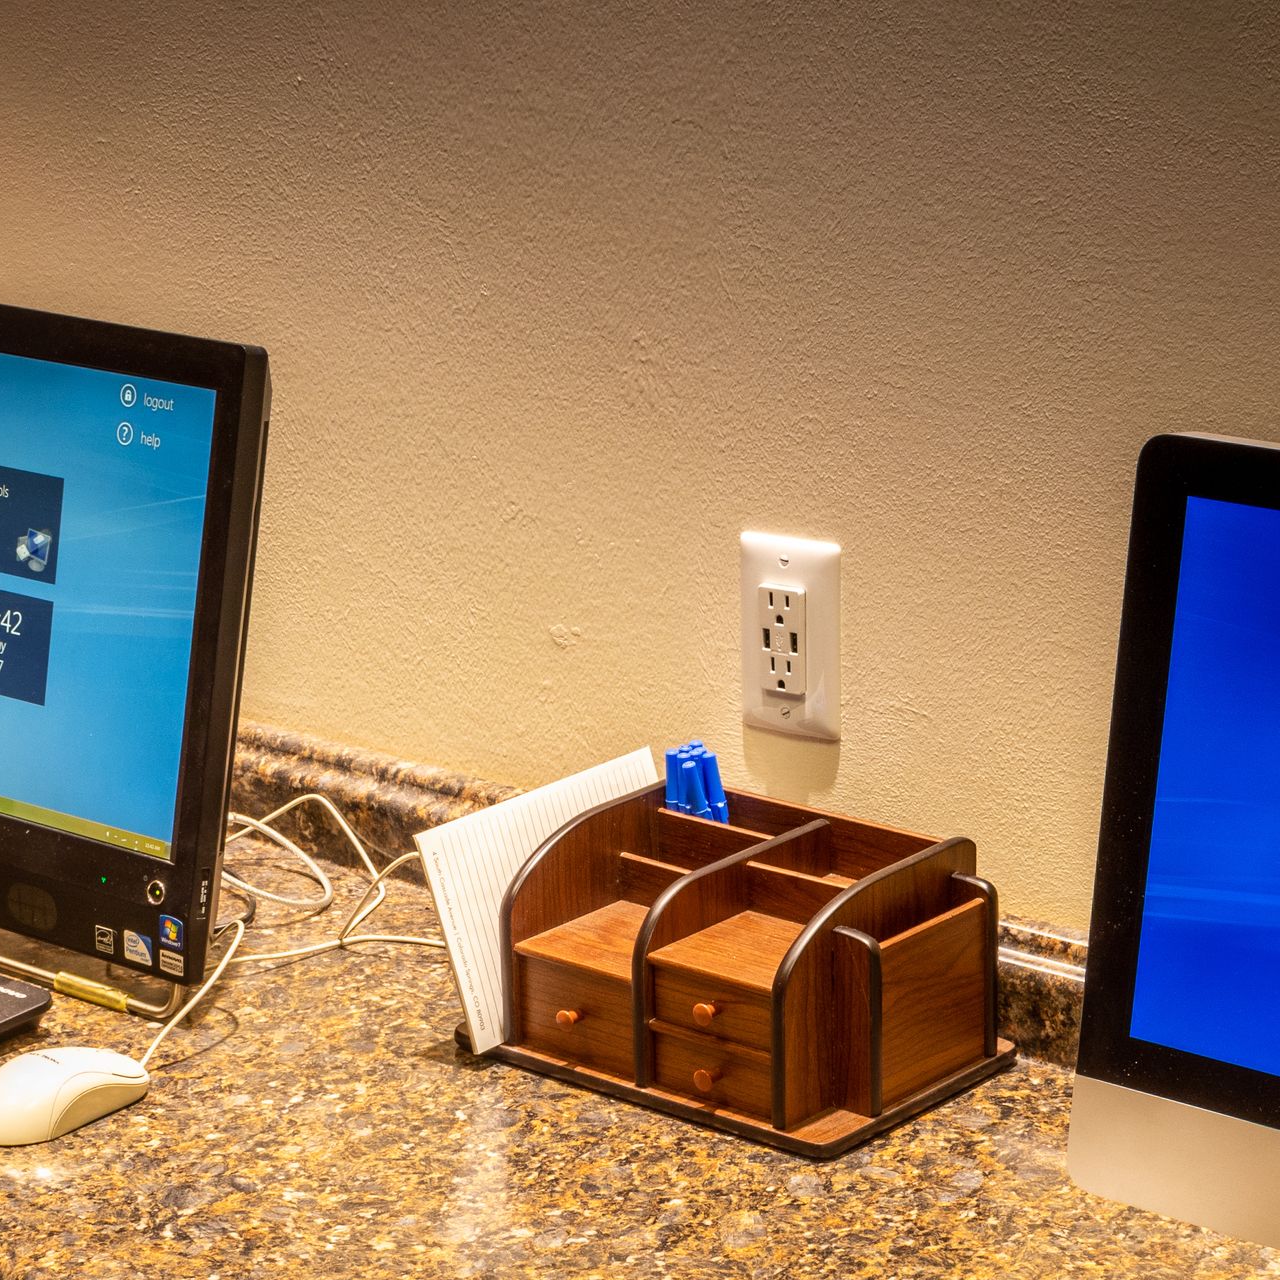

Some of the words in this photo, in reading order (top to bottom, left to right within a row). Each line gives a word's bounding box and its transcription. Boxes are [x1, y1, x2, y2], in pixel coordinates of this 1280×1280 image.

[144, 393, 174, 411] logout
[141, 431, 160, 449] help
[434, 857, 443, 878] South
[439, 877, 452, 907] Cascade
[447, 906, 457, 931] Avenue
[456, 937, 469, 969] Colorado
[473, 995, 480, 1008] CO
